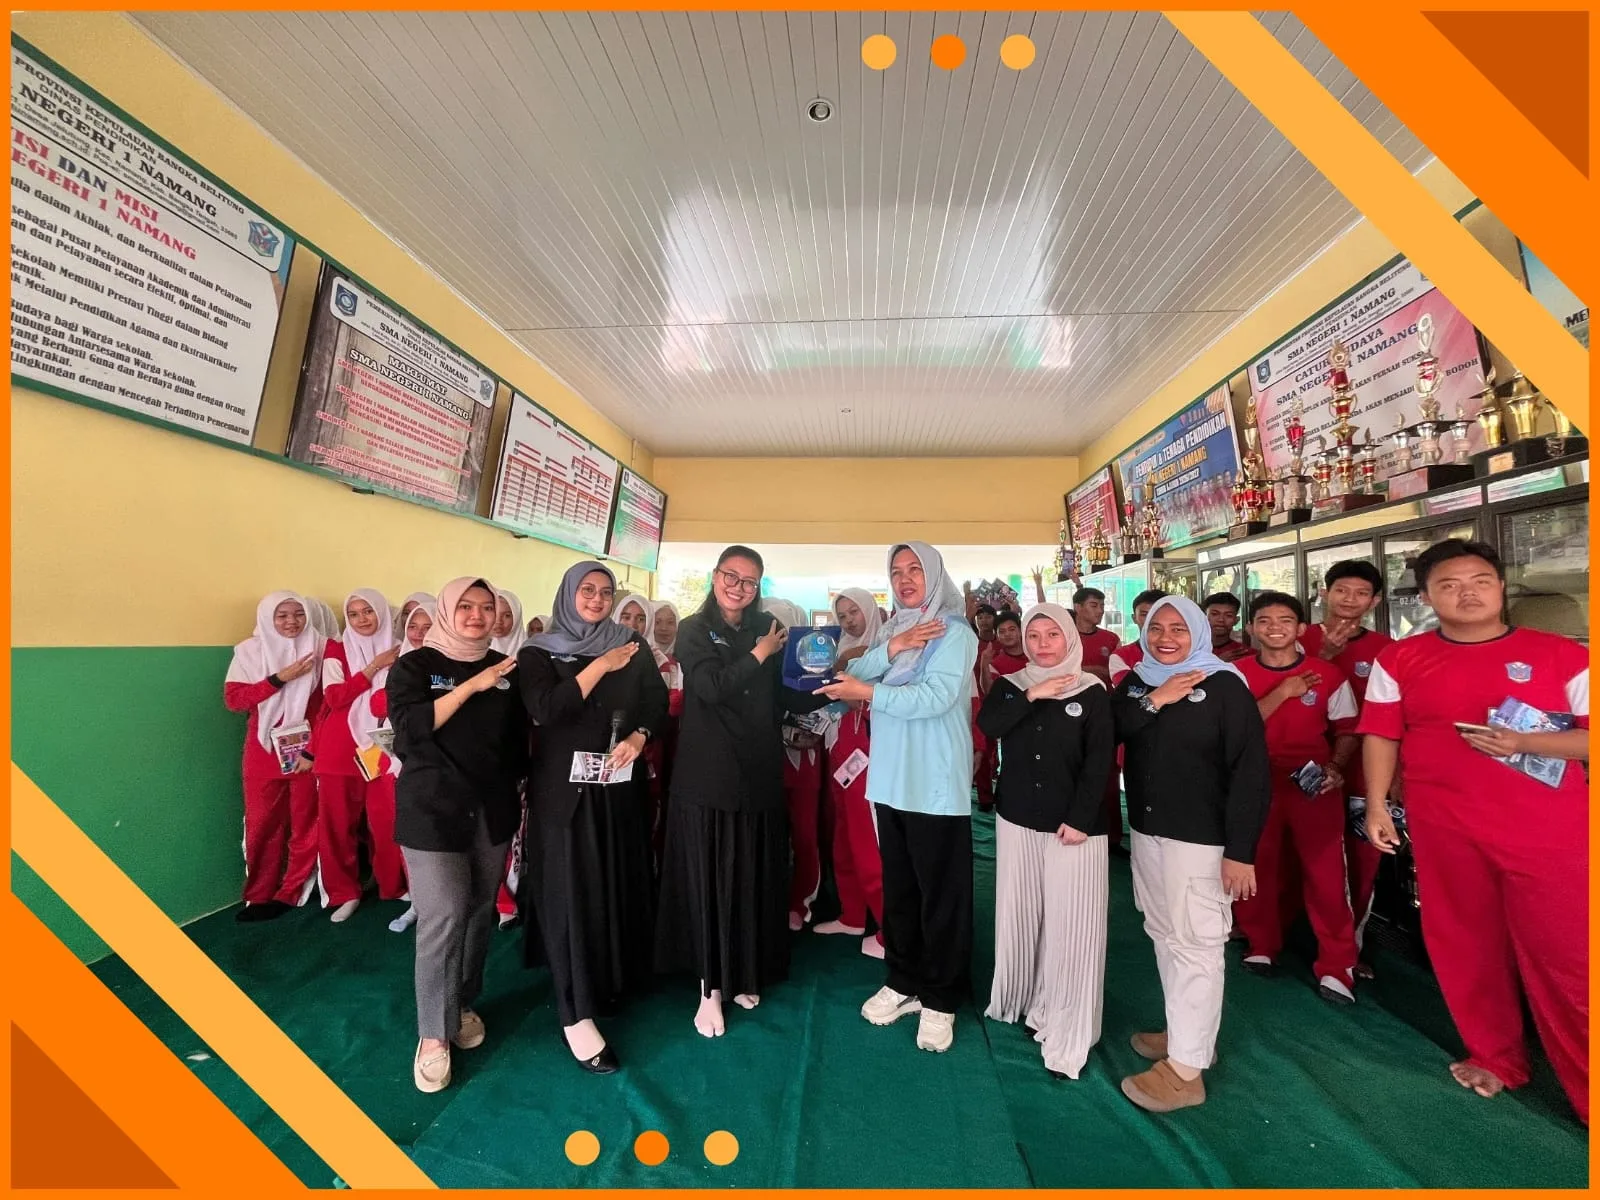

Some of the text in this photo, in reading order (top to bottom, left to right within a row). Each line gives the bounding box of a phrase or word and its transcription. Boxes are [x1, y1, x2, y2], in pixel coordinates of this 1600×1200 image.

[15, 56, 245, 214] PROVINSI KEPULAUAN BANGKA BELITUNG
[19, 82, 217, 217] NEGERI 1 NAMANG
[40, 84, 157, 165] DINAS PENDIDIKAN
[12, 126, 159, 222] ISI DAN MISI
[34, 189, 71, 214] dalam
[74, 210, 113, 237] Akhlak,
[117, 233, 135, 248] dan
[138, 243, 187, 275] Berkualitas
[189, 271, 214, 289] dalam
[215, 284, 252, 309] Pelayanan
[98, 198, 107, 211] 1
[117, 207, 196, 260] NAMANG
[12, 205, 251, 329] sebagai Pusat Pelayanan Akademik dan Administrasi
[30, 228, 53, 244] dan
[55, 239, 111, 273] Pelayanan
[114, 268, 144, 288] secara
[213, 316, 228, 328] dan
[25, 278, 67, 302] Melalui
[69, 296, 127, 327] Pendidikan
[129, 322, 160, 341] Agama
[162, 336, 178, 348] dan
[180, 343, 237, 372] Ekstrakurikuler
[54, 316, 79, 332] bagi
[82, 326, 113, 345] Warga
[116, 340, 153, 361] sekolah.
[59, 266, 104, 294] Memiliki
[107, 287, 144, 311] Prestasi
[147, 306, 174, 324] Tinggi
[175, 319, 200, 337] dalam
[202, 331, 228, 350] Bidang
[1287, 346, 1305, 361] SMA
[1306, 322, 1341, 350] NEGERI
[1350, 287, 1396, 322] NAMANG
[1566, 308, 1590, 328] ME
[11, 338, 73, 367] asyarakat.
[11, 326, 246, 416] yang Berhasil Guna dan Berdaya guna dengan Orang
[68, 334, 130, 363] Antarsesama
[134, 357, 161, 374] Warga
[163, 369, 197, 388] Sekolah.
[349, 348, 378, 372] SMA
[380, 364, 423, 396] NEGERI
[430, 393, 469, 420] NAMANG
[380, 322, 400, 339] SMA
[401, 335, 432, 360] NEGERI
[439, 360, 469, 383] NAMANG
[388, 354, 447, 395] MAKLUMAT
[1276, 389, 1298, 406] SMA
[1356, 323, 1418, 363] NAMANG
[1295, 358, 1331, 383] CATUR
[1354, 377, 1372, 389] AKAN
[1372, 362, 1401, 380] PERNAH
[1365, 400, 1383, 411] AKAN
[1445, 358, 1479, 377] BODOH
[11, 351, 250, 436] Lingkungan dengan Mencegah Terjadinya Pencemaran
[1163, 437, 1185, 462] TENAGA
[1185, 411, 1227, 448] PENDIDIKAN
